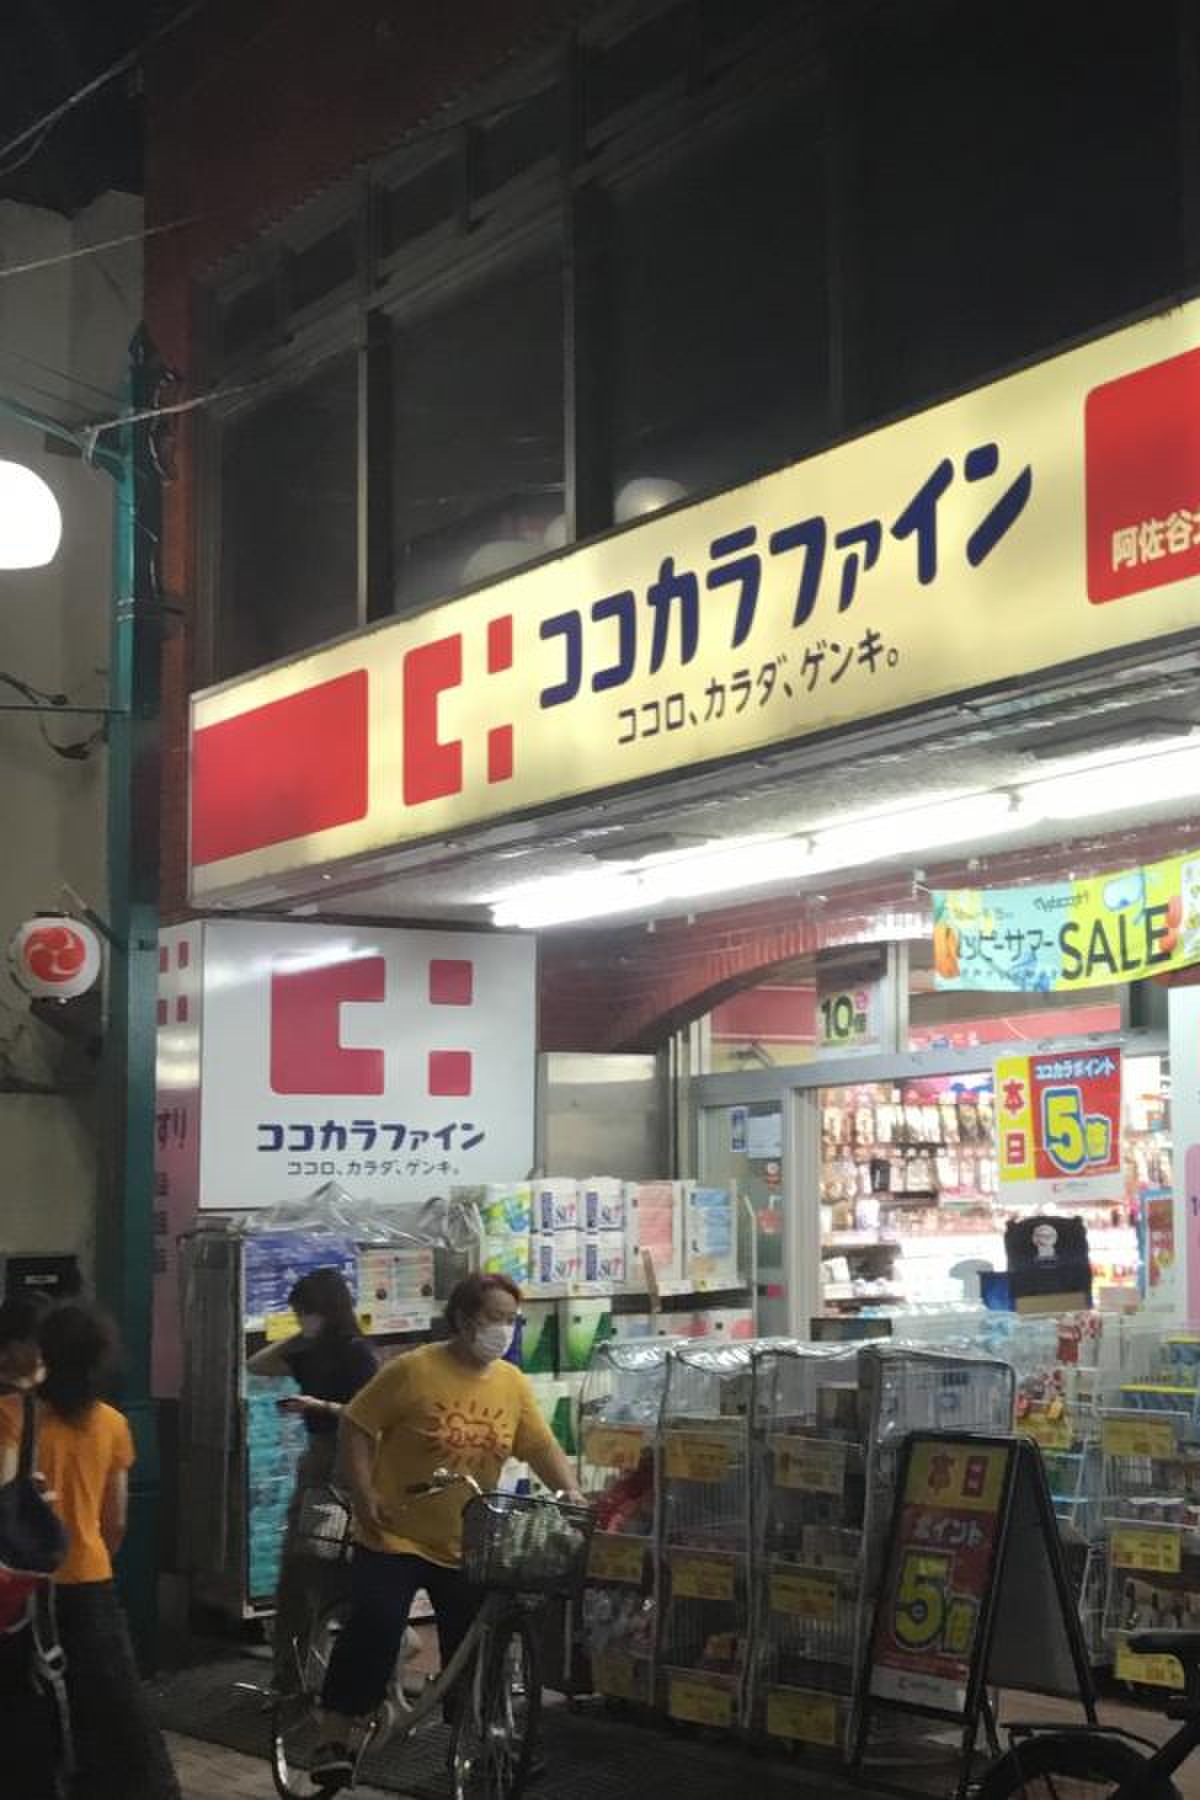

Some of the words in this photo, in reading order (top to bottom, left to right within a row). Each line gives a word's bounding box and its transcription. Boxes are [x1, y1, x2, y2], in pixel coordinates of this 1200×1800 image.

[540, 443, 1032, 709] ココカラファイン
[618, 628, 899, 744] ココロ、カラダ、ゲンキ。
[1058, 903, 1173, 981] SALE
[257, 1120, 485, 1152] ココカラファイン
